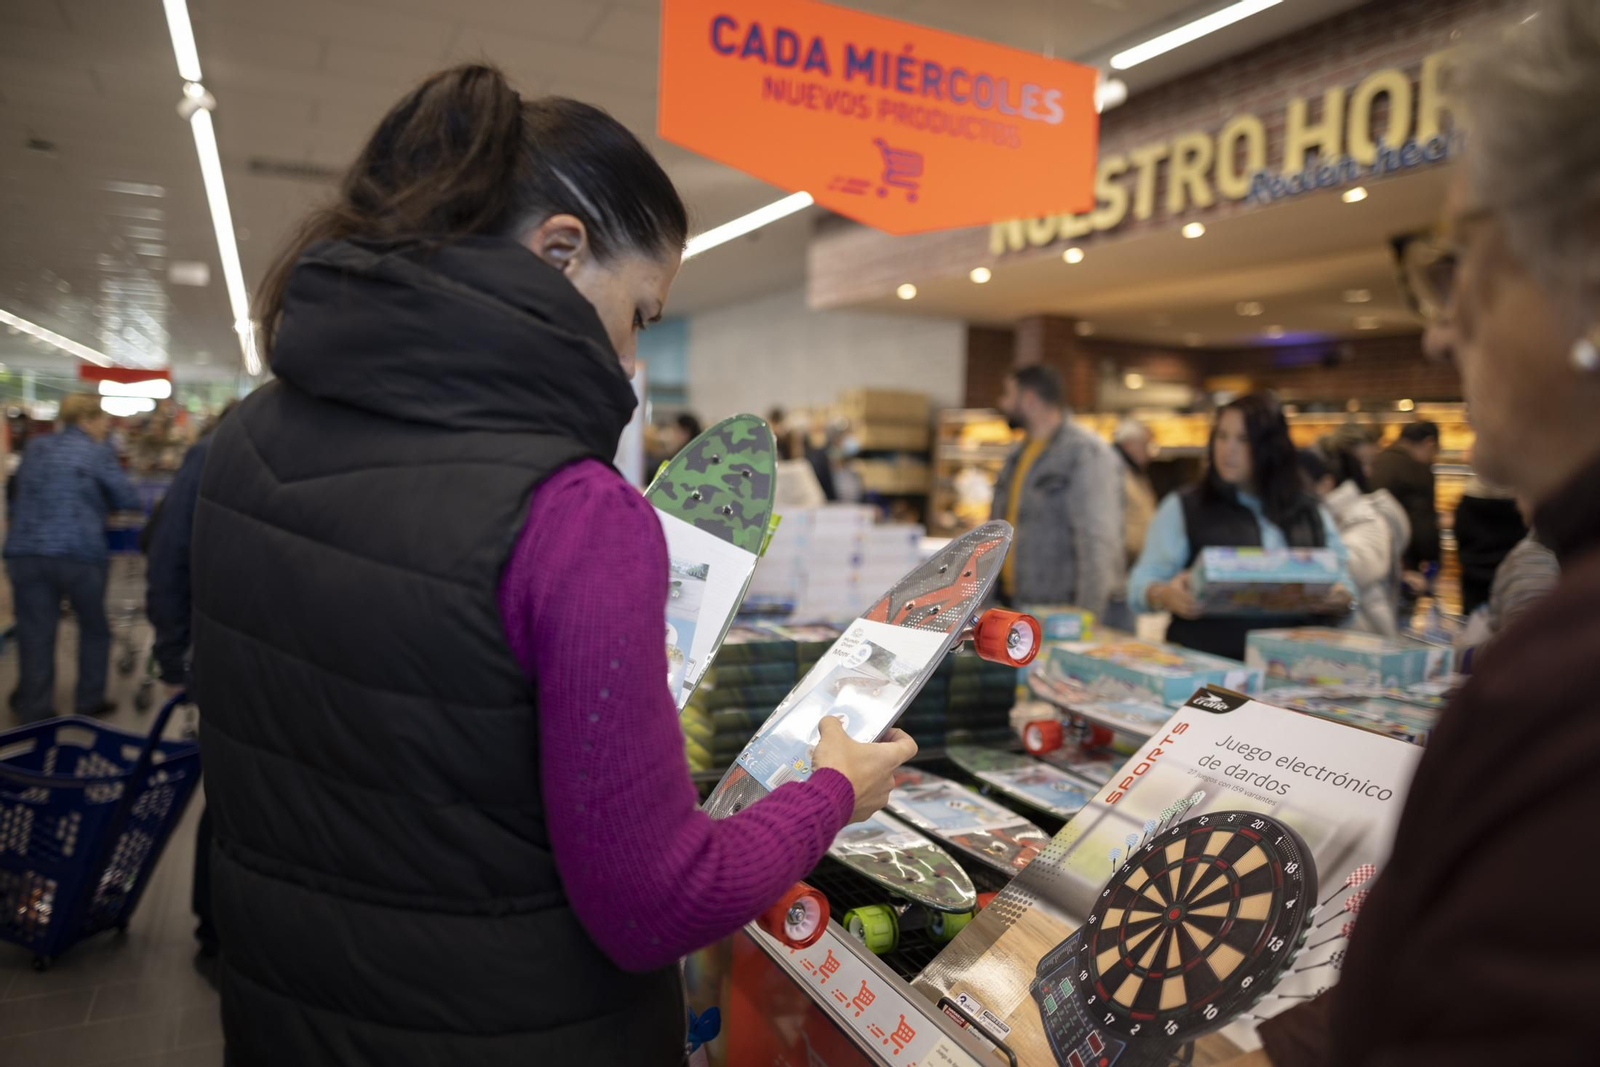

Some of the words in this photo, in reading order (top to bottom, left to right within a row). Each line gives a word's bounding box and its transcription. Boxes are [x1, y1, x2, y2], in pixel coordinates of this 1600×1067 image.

[709, 15, 830, 76] CADA
[844, 43, 1065, 124] MIÉRCOLES
[762, 76, 871, 119] NUEVOS
[877, 98, 1021, 149] PRODUCTOS
[1105, 721, 1190, 805] SPORTS
[1215, 735, 1272, 761] Juego
[1275, 755, 1393, 802] electrónico
[1198, 754, 1222, 771] de
[1223, 763, 1292, 796] dardos
[1196, 773, 1217, 784] juegos
[1218, 780, 1231, 789] con
[1244, 789, 1278, 807] variantes
[1198, 816, 1209, 826] 12
[1228, 814, 1236, 823] 5
[1251, 818, 1265, 830] 20
[1172, 827, 1180, 835] 9
[1274, 836, 1283, 846] 1
[1145, 843, 1154, 852] 14
[1122, 864, 1131, 873] 11
[1284, 861, 1298, 875] 18
[1102, 889, 1110, 897] 8
[1285, 898, 1296, 909] 4
[1088, 913, 1097, 925] 16
[1080, 944, 1088, 952] 7
[1268, 936, 1285, 952] 13
[1079, 970, 1088, 981] 19
[1241, 976, 1253, 989] 6
[1087, 995, 1096, 1005] 3
[1202, 1003, 1219, 1021] 10
[1103, 1013, 1115, 1025] 17
[1130, 1024, 1141, 1036] 2
[1164, 1020, 1180, 1036] 15
